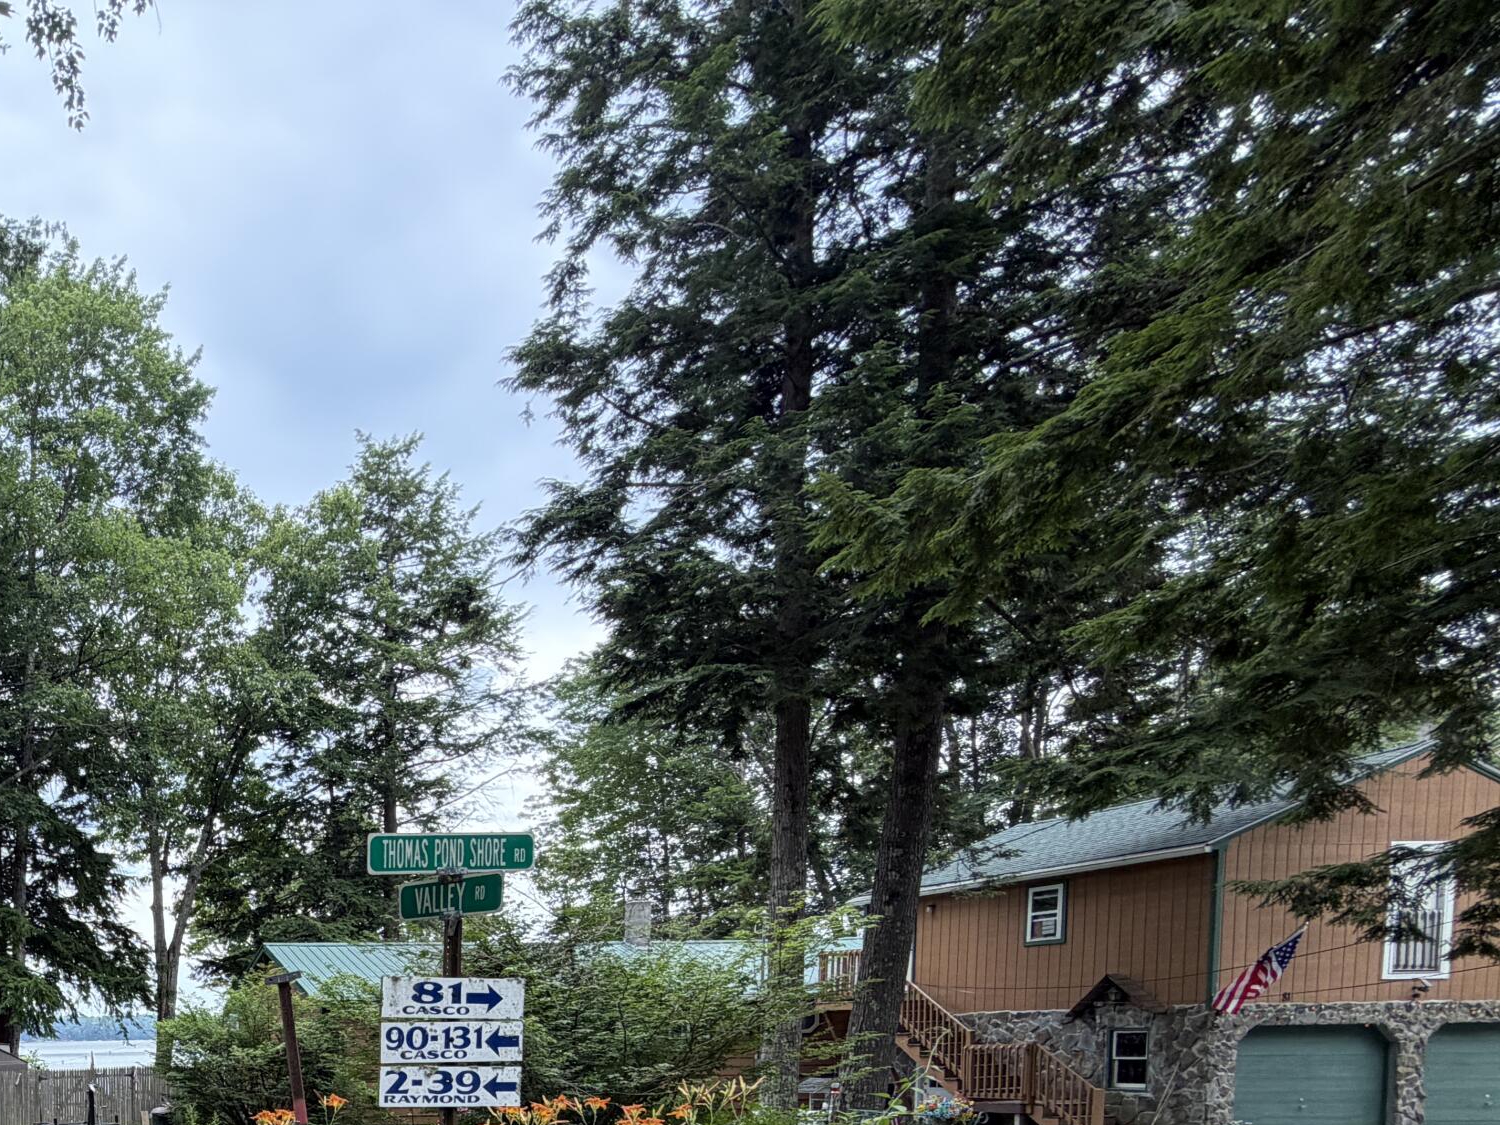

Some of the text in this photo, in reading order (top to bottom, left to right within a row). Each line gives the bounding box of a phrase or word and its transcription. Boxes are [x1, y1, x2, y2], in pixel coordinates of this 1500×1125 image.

[382, 838, 526, 869] THOMAS POND SHORE RD
[414, 881, 486, 914] VALLEY RD
[411, 981, 463, 1005] 81
[402, 1005, 470, 1016] CASCO
[385, 1025, 483, 1051] 90-131
[400, 1050, 468, 1060] CASCO
[384, 1069, 482, 1095] 2-39
[383, 1094, 481, 1104] RAYMOND
